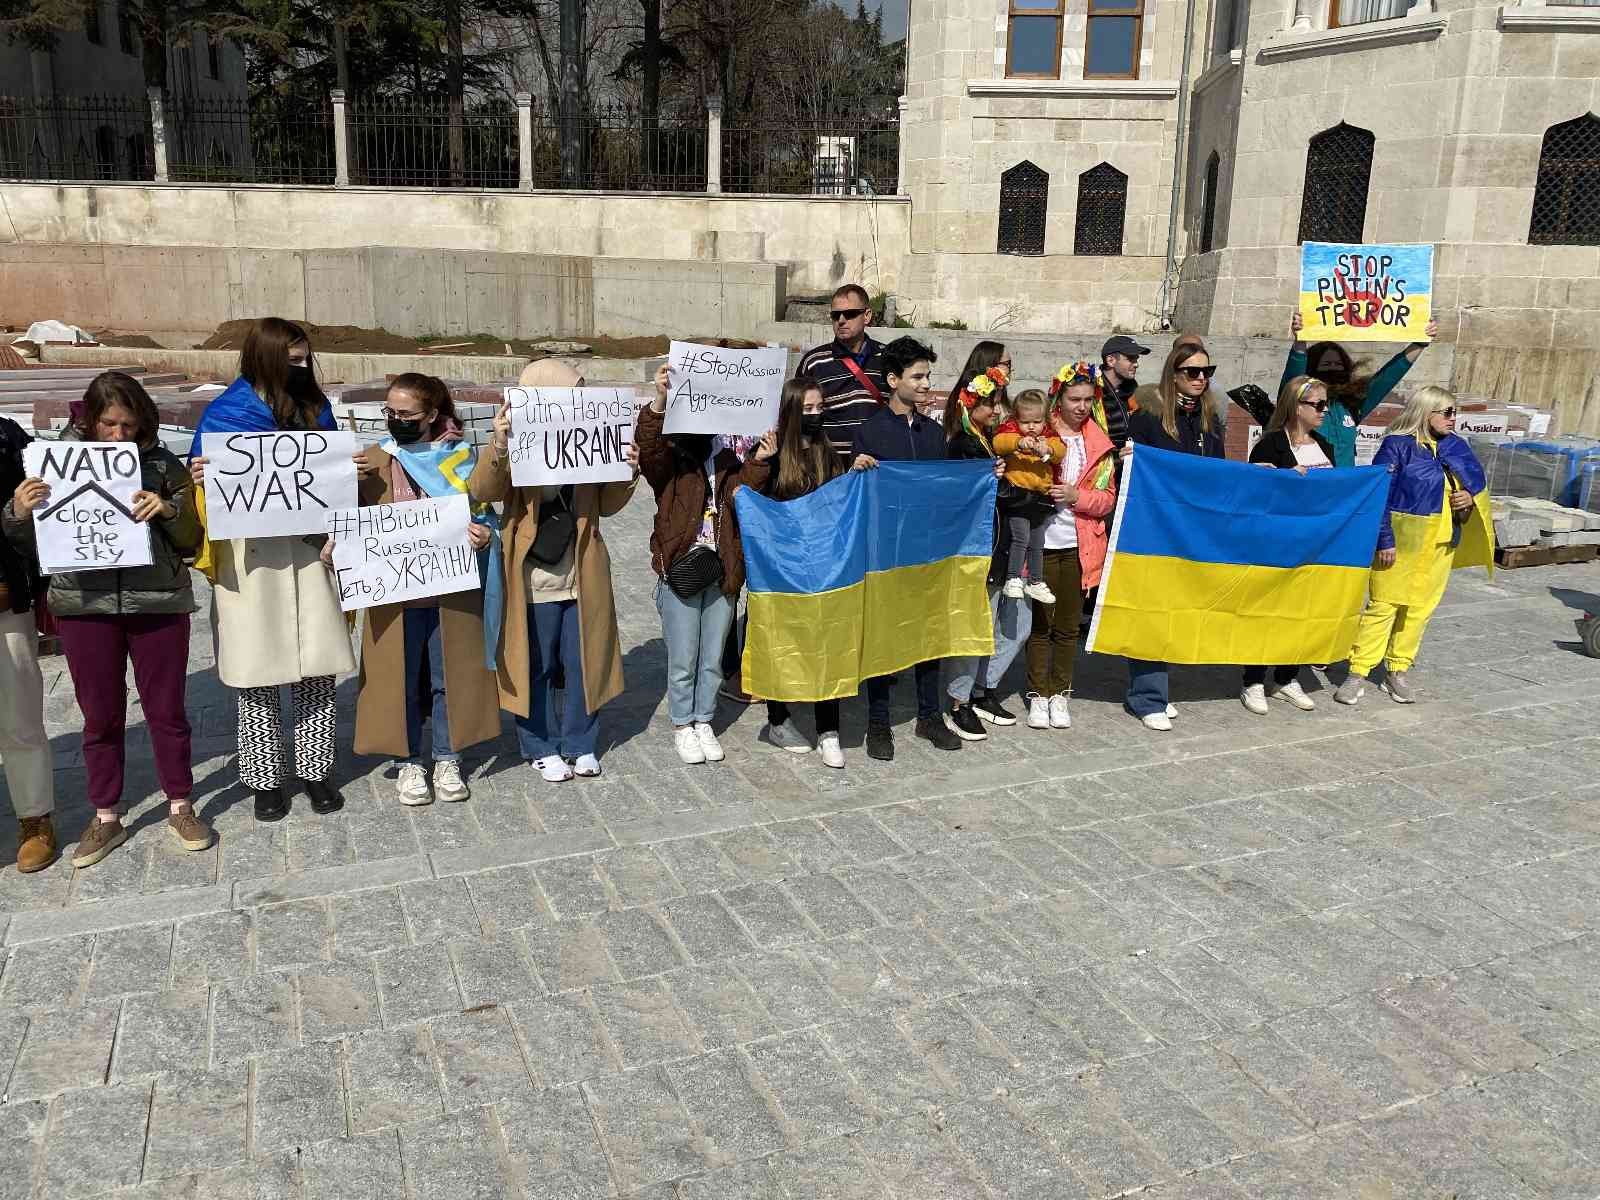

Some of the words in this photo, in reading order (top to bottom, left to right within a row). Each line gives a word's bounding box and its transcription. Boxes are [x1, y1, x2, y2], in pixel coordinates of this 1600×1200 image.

[1338, 254, 1393, 278] STOP
[1316, 302, 1411, 328] TERROR
[680, 351, 781, 381] #StopRussian
[508, 388, 565, 424] Putin
[572, 388, 632, 422] Hands
[671, 379, 763, 412] Aggression
[40, 447, 138, 481] NATO
[219, 433, 328, 475] STOP
[511, 432, 536, 464] off
[213, 470, 329, 512] WAR
[56, 504, 119, 525] close
[73, 526, 119, 547] the
